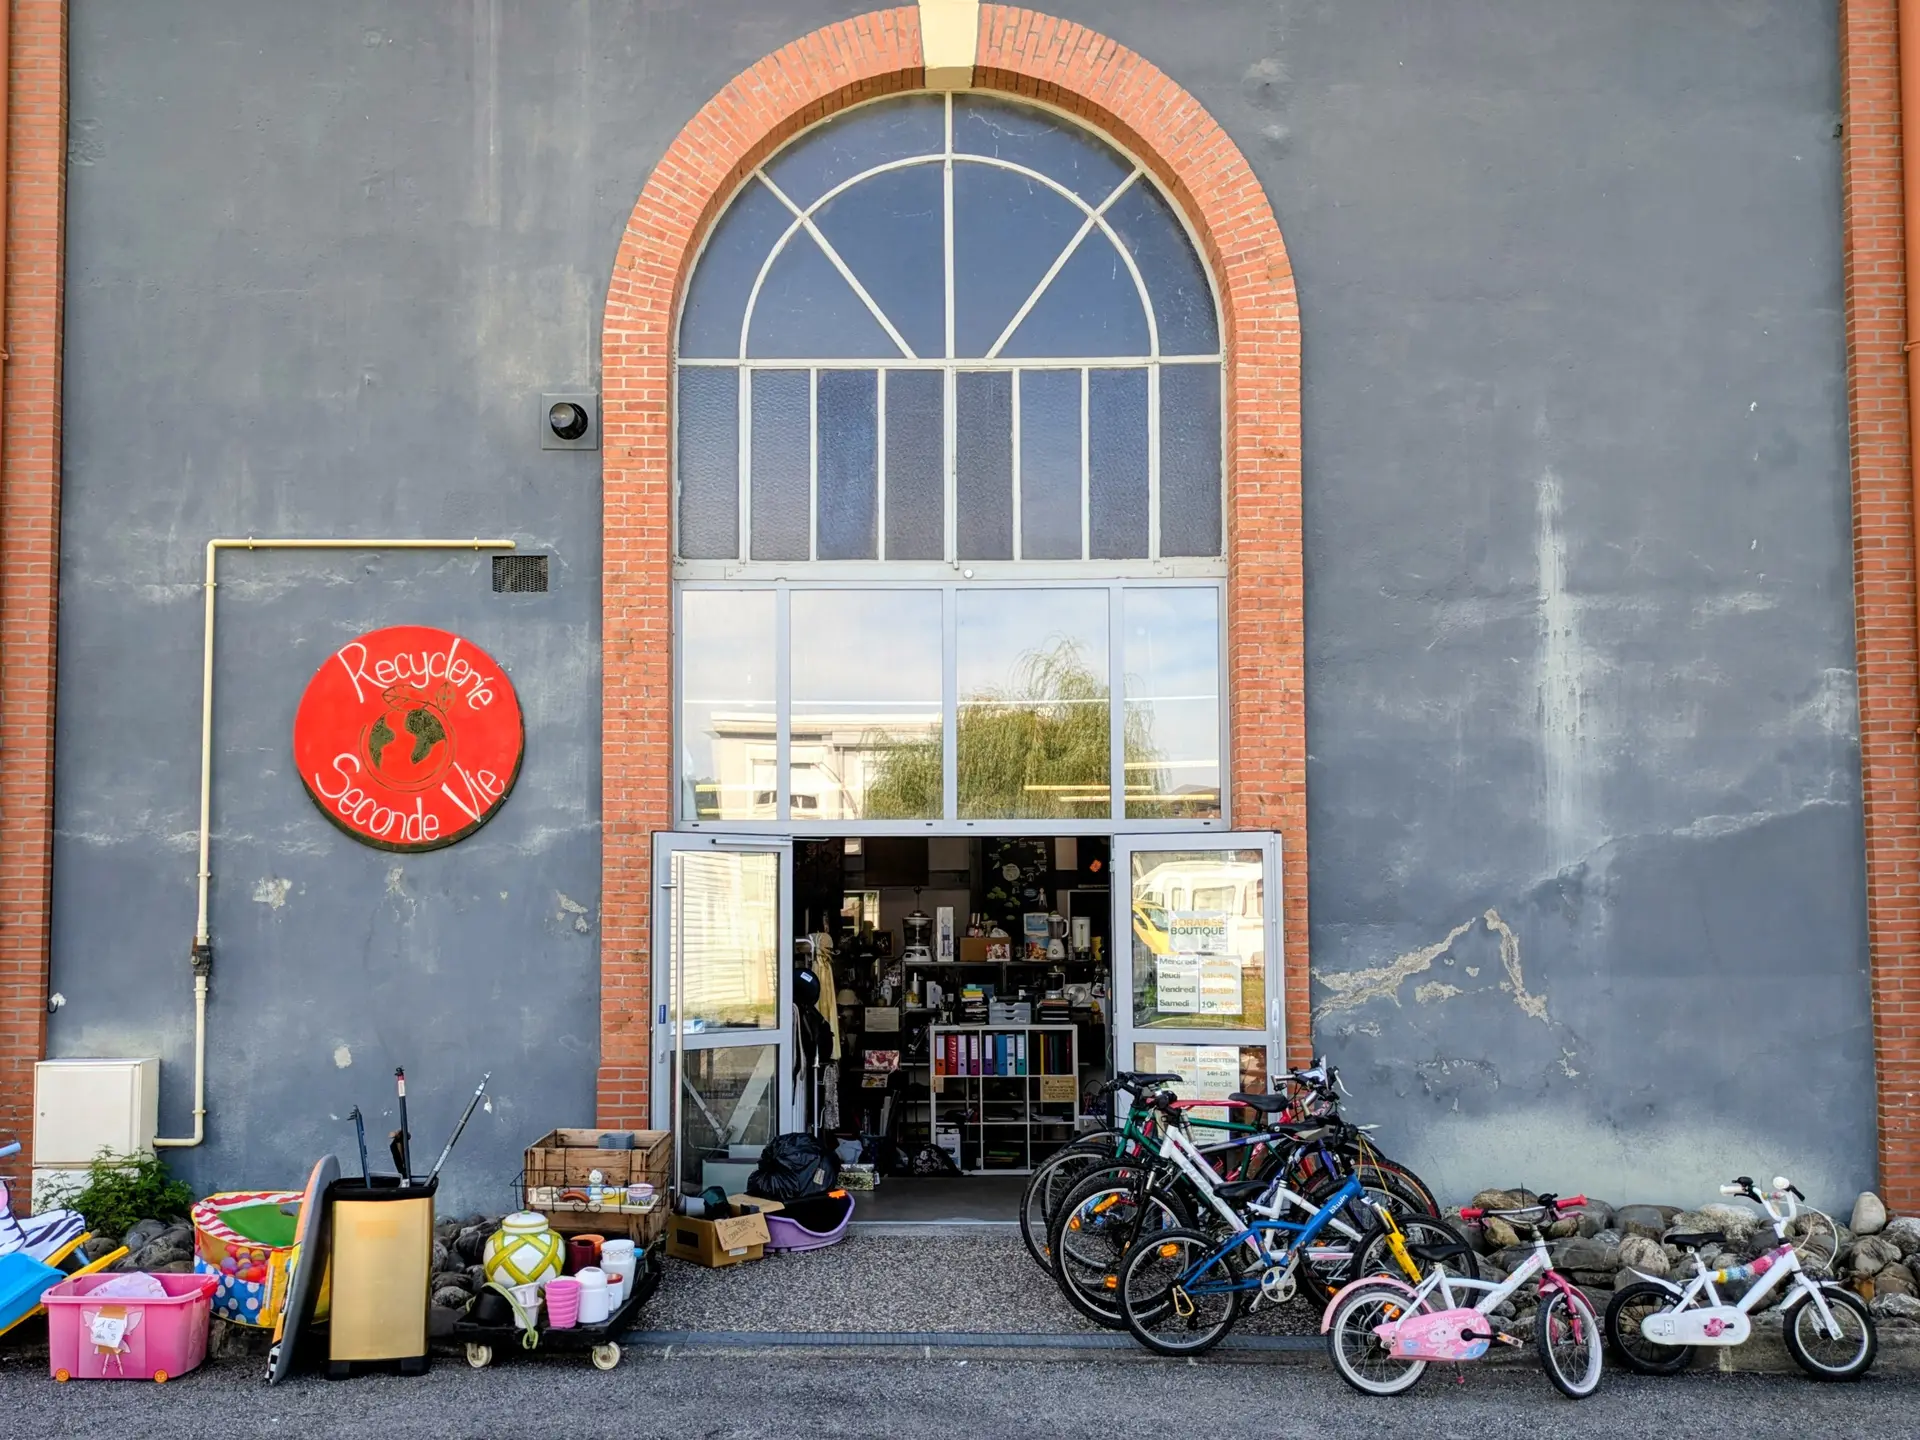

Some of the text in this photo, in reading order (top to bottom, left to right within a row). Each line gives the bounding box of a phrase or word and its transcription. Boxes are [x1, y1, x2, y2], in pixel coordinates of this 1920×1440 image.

[315, 753, 505, 841] Seconde Vie
[1170, 927, 1225, 937] BOUTIQUE
[1159, 958, 1197, 966] Mercredi
[1159, 985, 1196, 993] Vendredi
[1203, 1080, 1233, 1088] interdit
